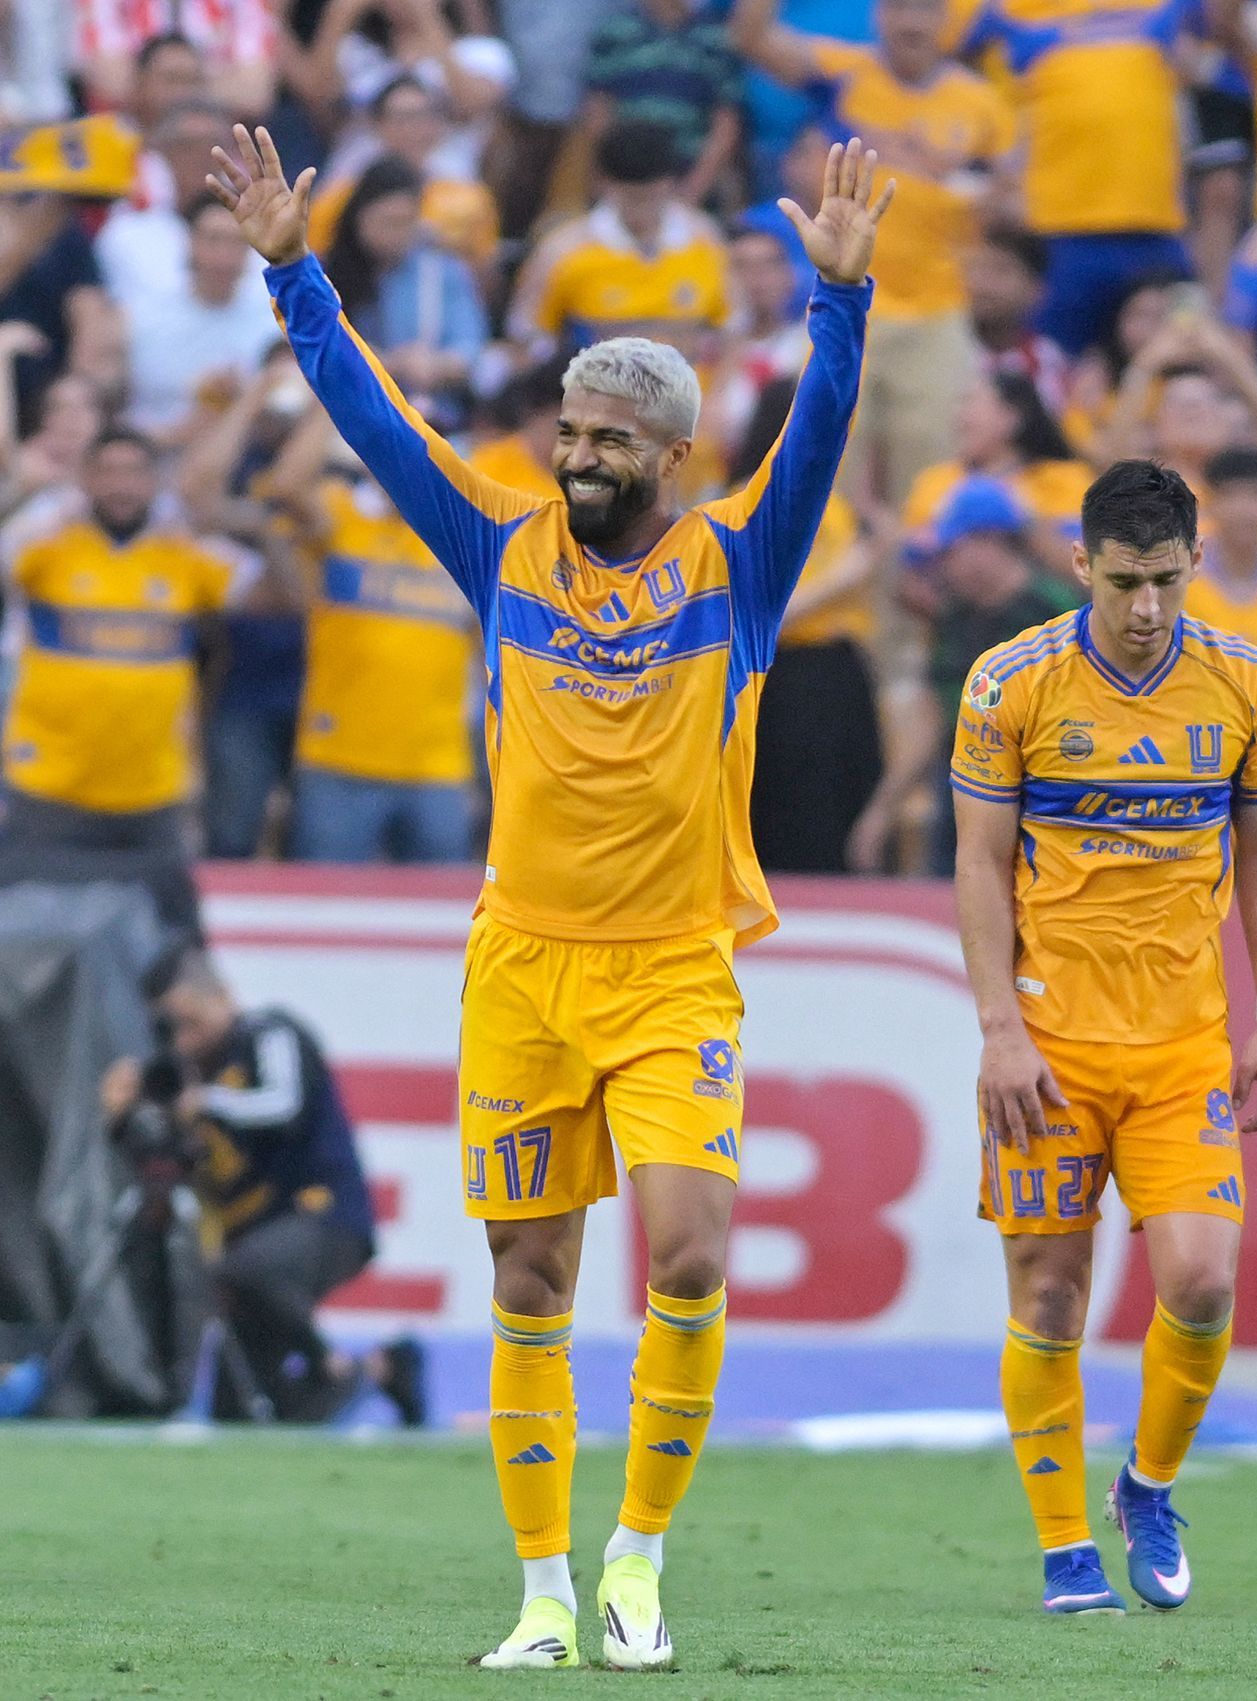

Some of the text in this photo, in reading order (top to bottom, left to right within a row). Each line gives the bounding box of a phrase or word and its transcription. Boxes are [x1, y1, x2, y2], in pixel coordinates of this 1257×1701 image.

[1105, 797, 1204, 818] CEMEX
[475, 1097, 525, 1113] CEMEX
[1046, 1124, 1079, 1136] MEX
[494, 1126, 551, 1200] 17
[1057, 1153, 1104, 1218] 27
